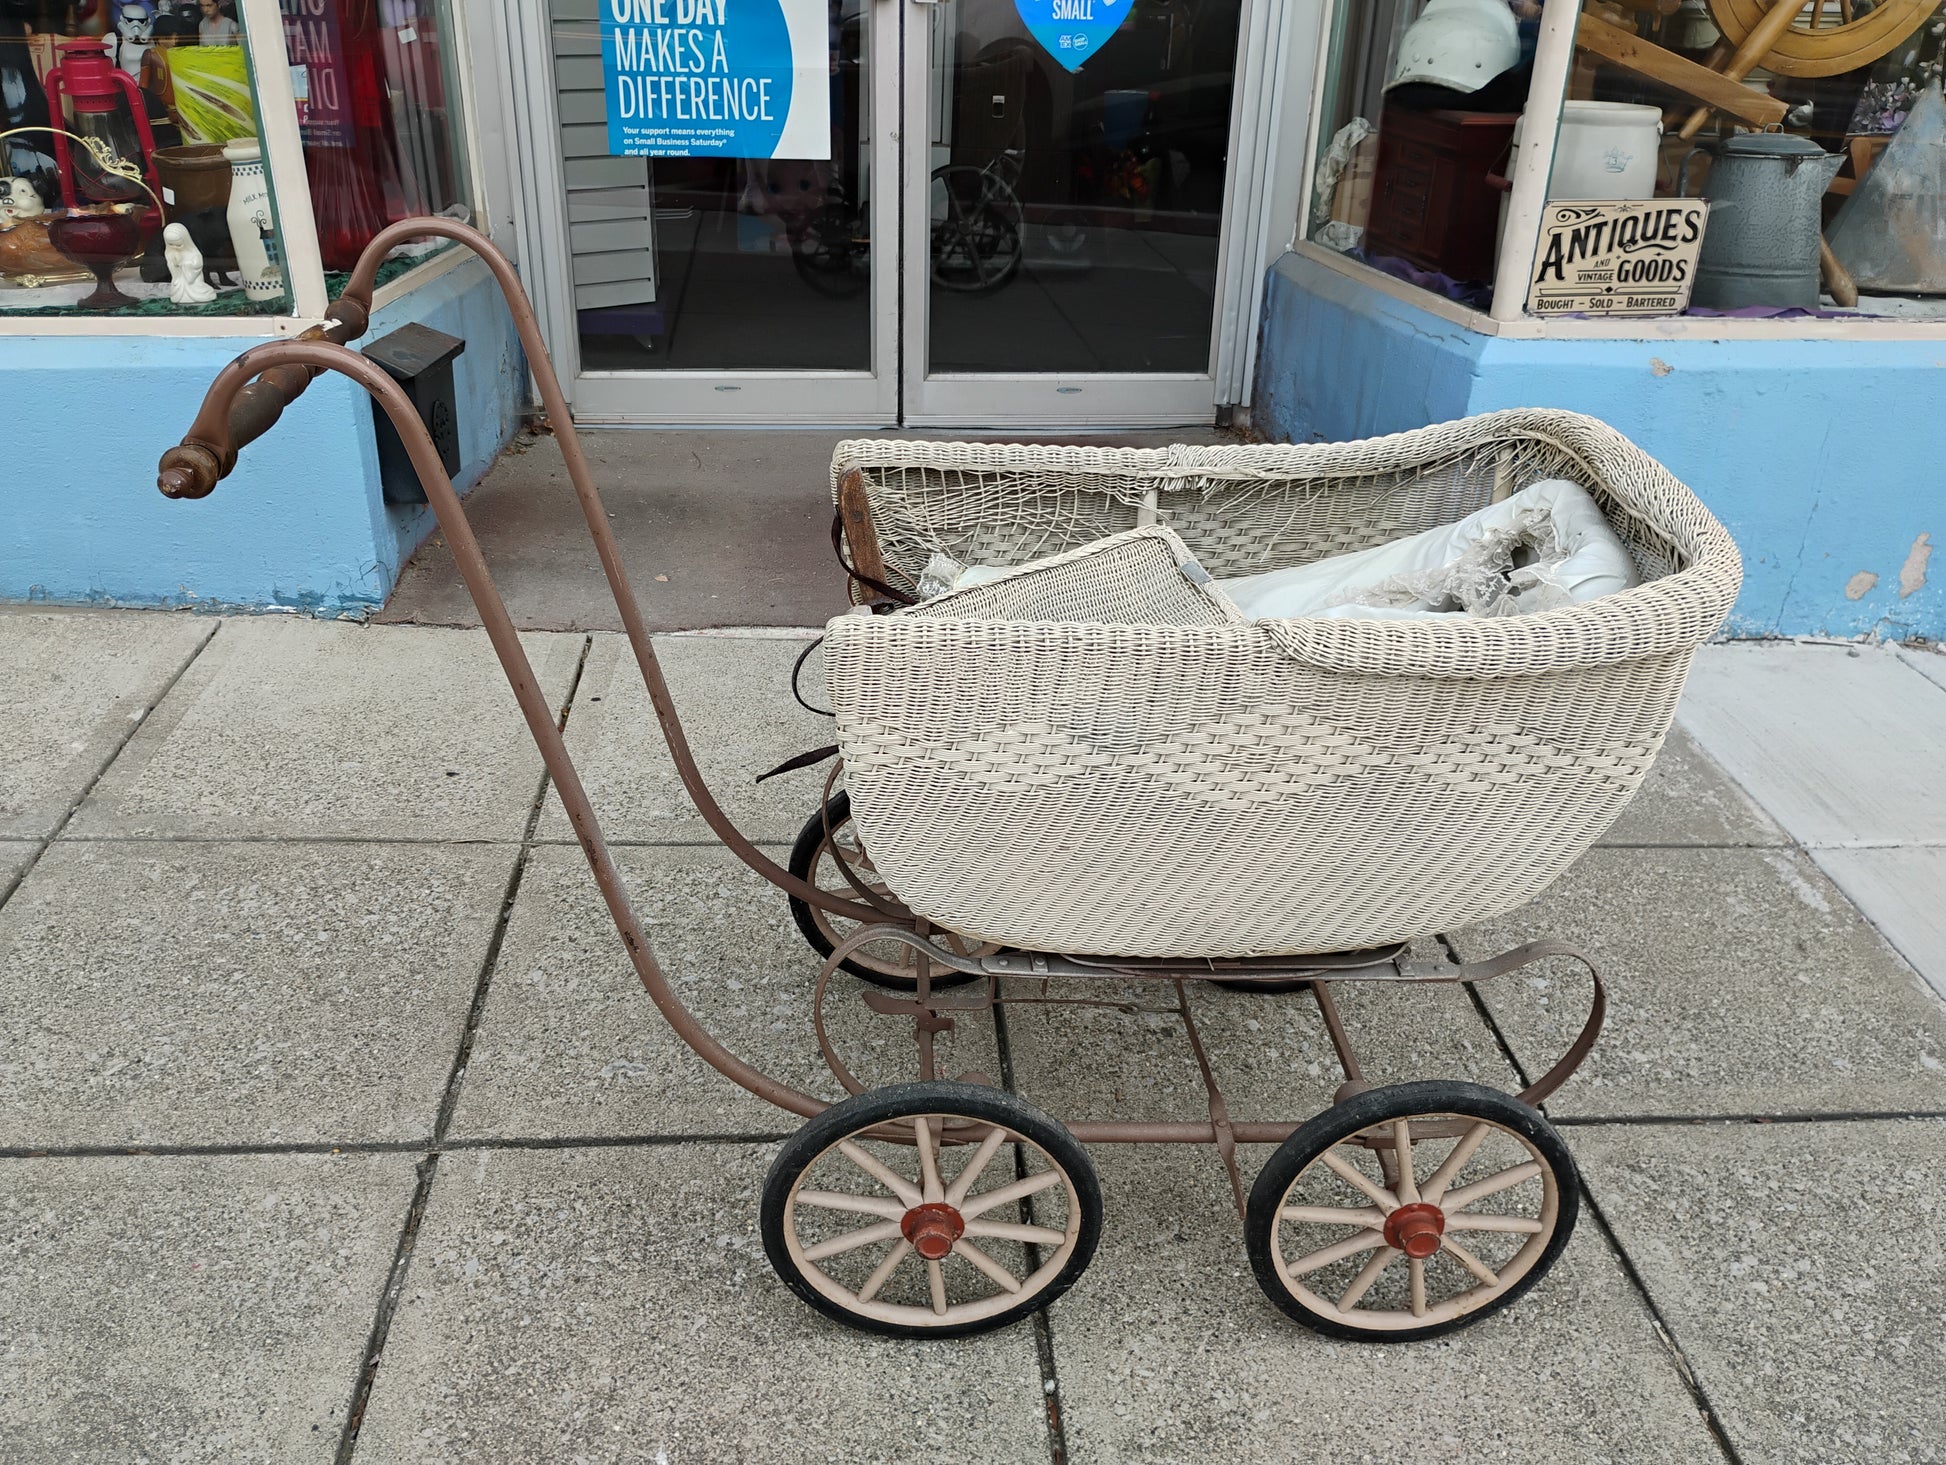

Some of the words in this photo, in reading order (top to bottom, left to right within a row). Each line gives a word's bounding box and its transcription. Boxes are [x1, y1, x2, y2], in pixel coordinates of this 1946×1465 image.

[611, 0, 669, 24] ONE
[676, 0, 726, 25] DAY
[1052, 0, 1093, 20] SMALL
[614, 28, 705, 73] MAKES
[711, 29, 729, 73] A
[618, 76, 774, 121] DIFFERENCE
[623, 127, 639, 135] Your
[641, 127, 669, 136] support
[696, 128, 735, 138] everything
[634, 137, 655, 145] Small
[657, 138, 689, 146] Business
[649, 149, 665, 157] year
[667, 148, 690, 156] round.
[1535, 208, 1701, 284] ANTIQUES
[1577, 272, 1615, 282] VINTAGE
[1616, 258, 1688, 283] GOODS
[1593, 258, 1611, 269] AND
[1536, 298, 1575, 310] BOUGHT
[1588, 297, 1613, 309] SOLD
[1626, 296, 1676, 309] BARTERED
